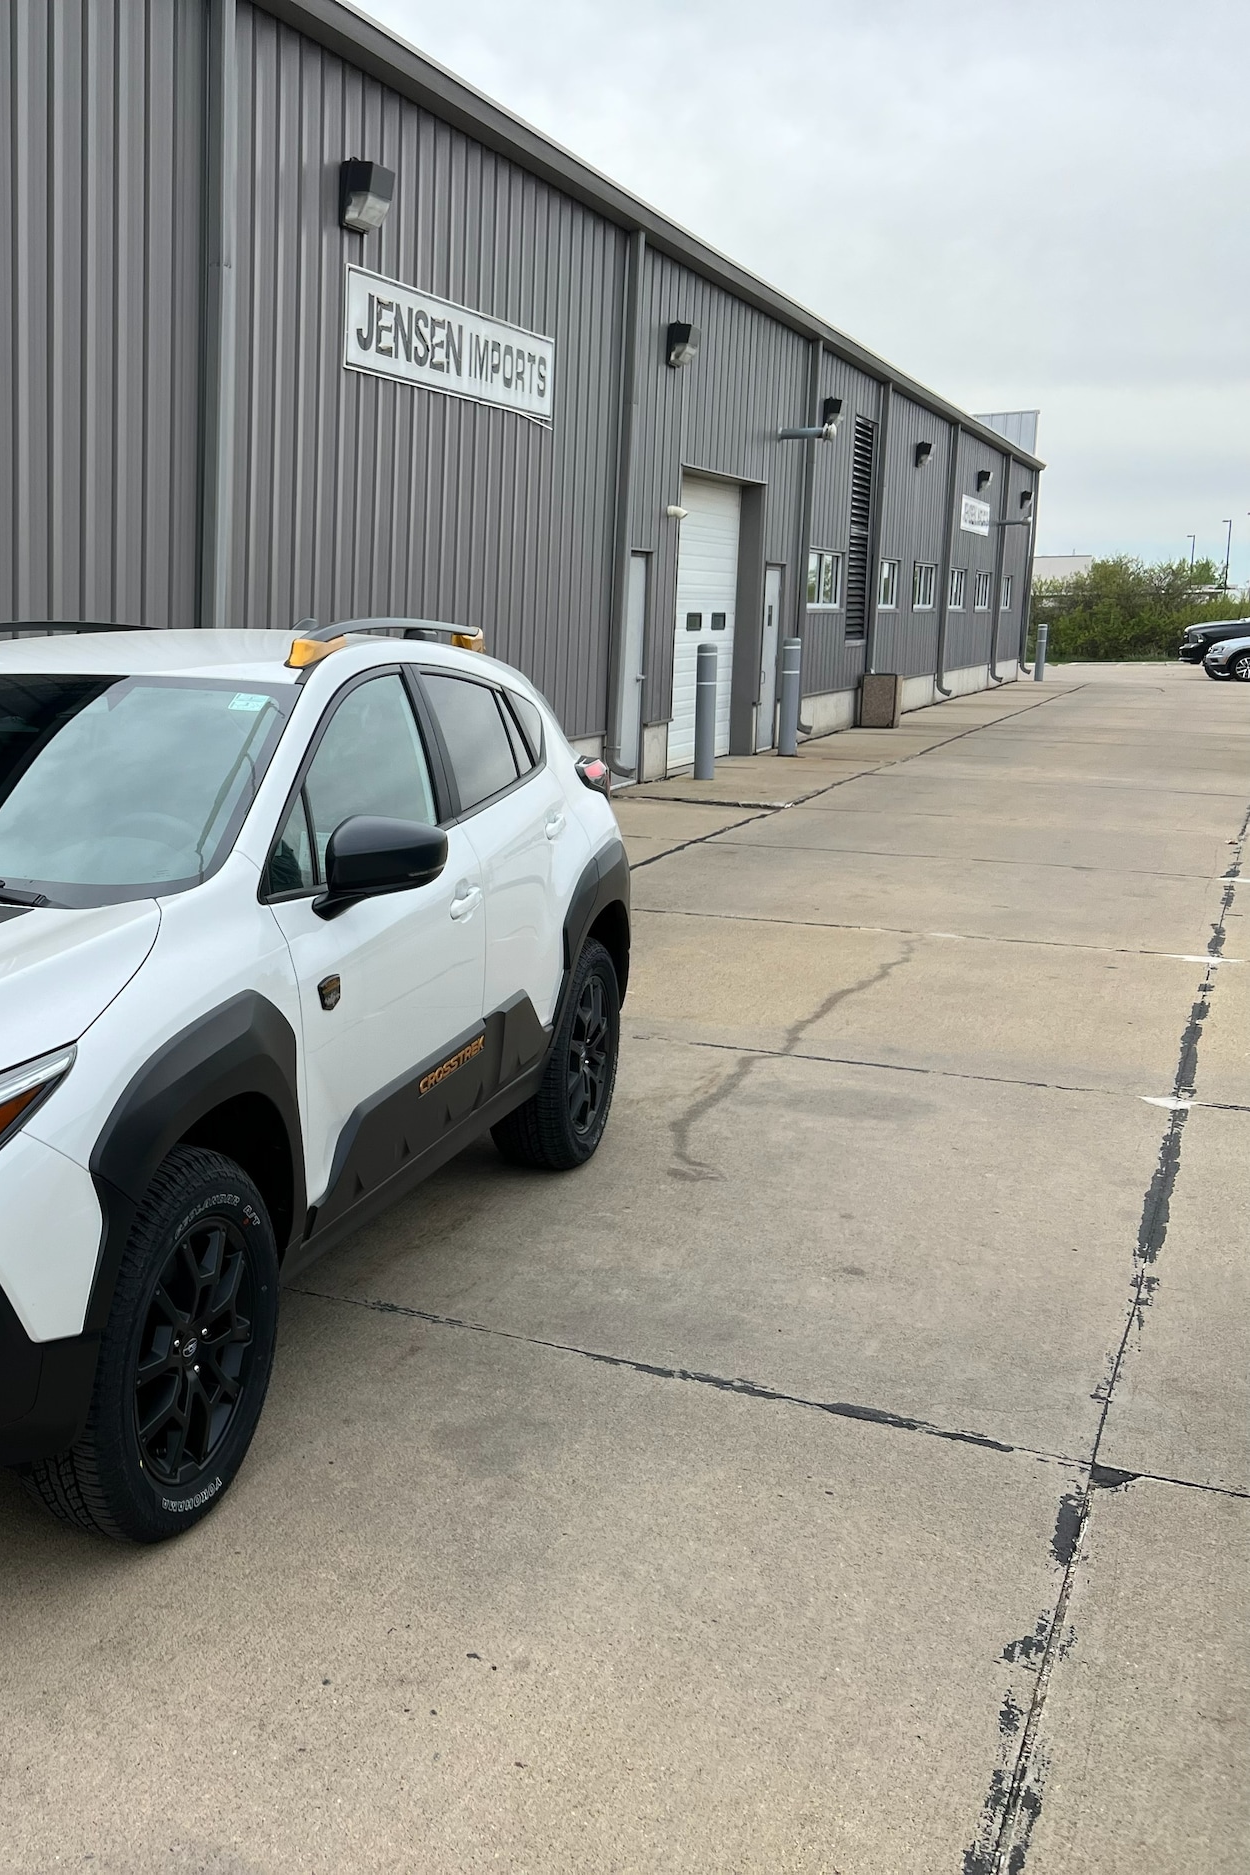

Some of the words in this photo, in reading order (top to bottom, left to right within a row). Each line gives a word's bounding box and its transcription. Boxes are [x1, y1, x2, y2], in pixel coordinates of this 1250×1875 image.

[356, 292, 463, 377] JENSEN
[468, 332, 547, 398] IMPORTS
[419, 1035, 484, 1094] CROSSTREK
[161, 1476, 223, 1512] YOKOHAMA
